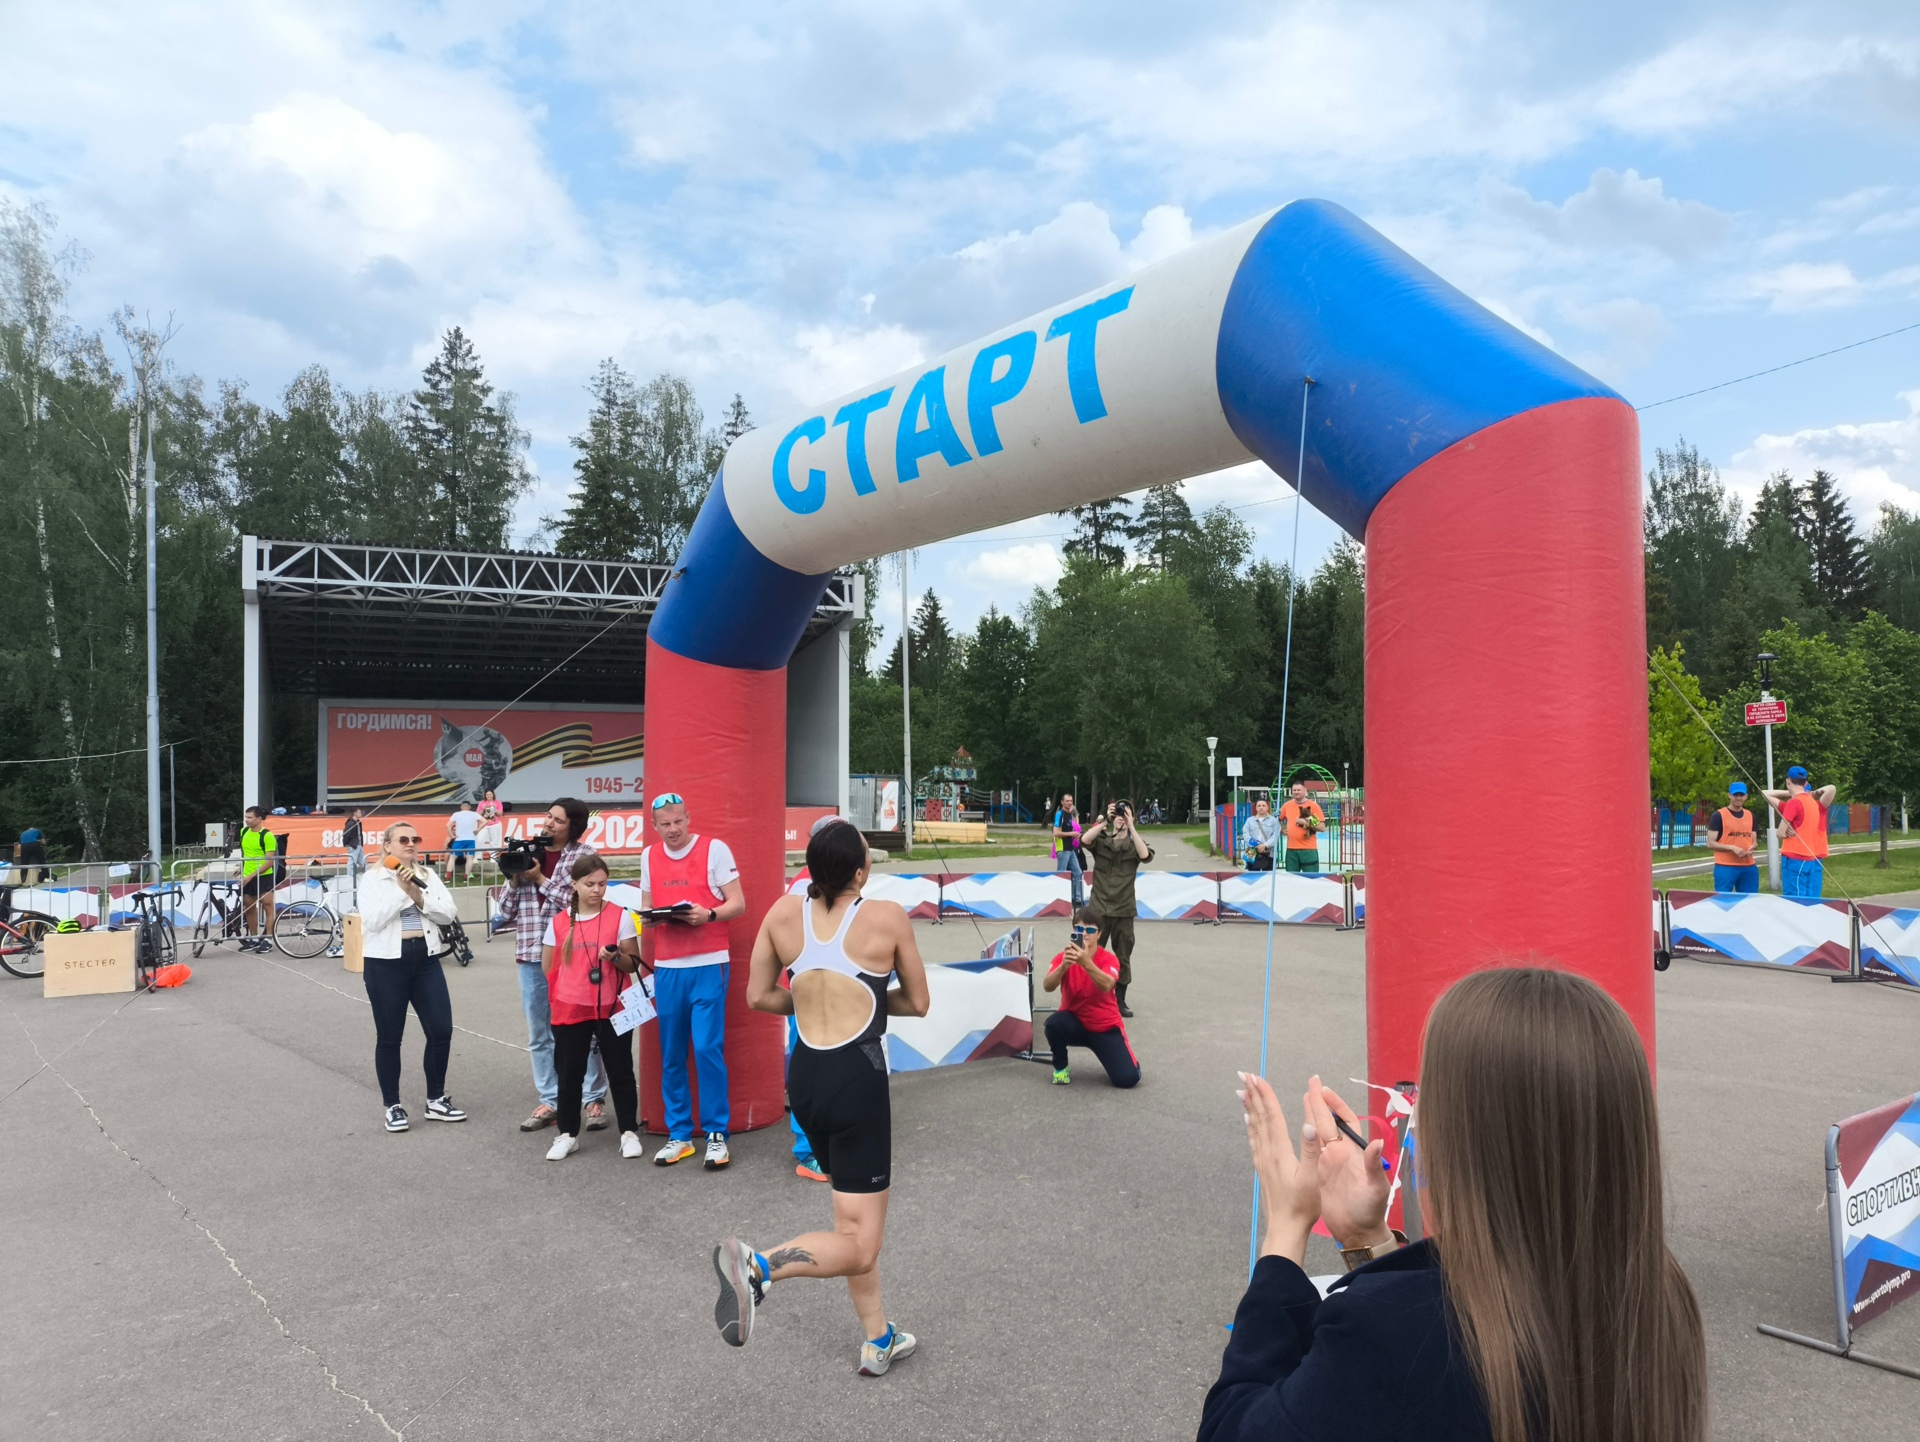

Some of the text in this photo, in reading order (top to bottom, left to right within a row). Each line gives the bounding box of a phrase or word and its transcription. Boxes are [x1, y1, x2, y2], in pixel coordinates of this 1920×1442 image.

[772, 284, 1136, 514] СТАРТ
[337, 713, 432, 732] ГОРДИМСЯ!
[465, 753, 482, 762] МАЯ
[585, 776, 643, 793] 1945-2
[322, 830, 344, 848] 80
[585, 815, 643, 849] 202
[663, 879, 689, 888] KIPSTA
[64, 958, 116, 970] STECTER
[1846, 1165, 1920, 1227] СПОРТИВН
[1853, 1269, 1911, 1314] www.sportolymp.pro
